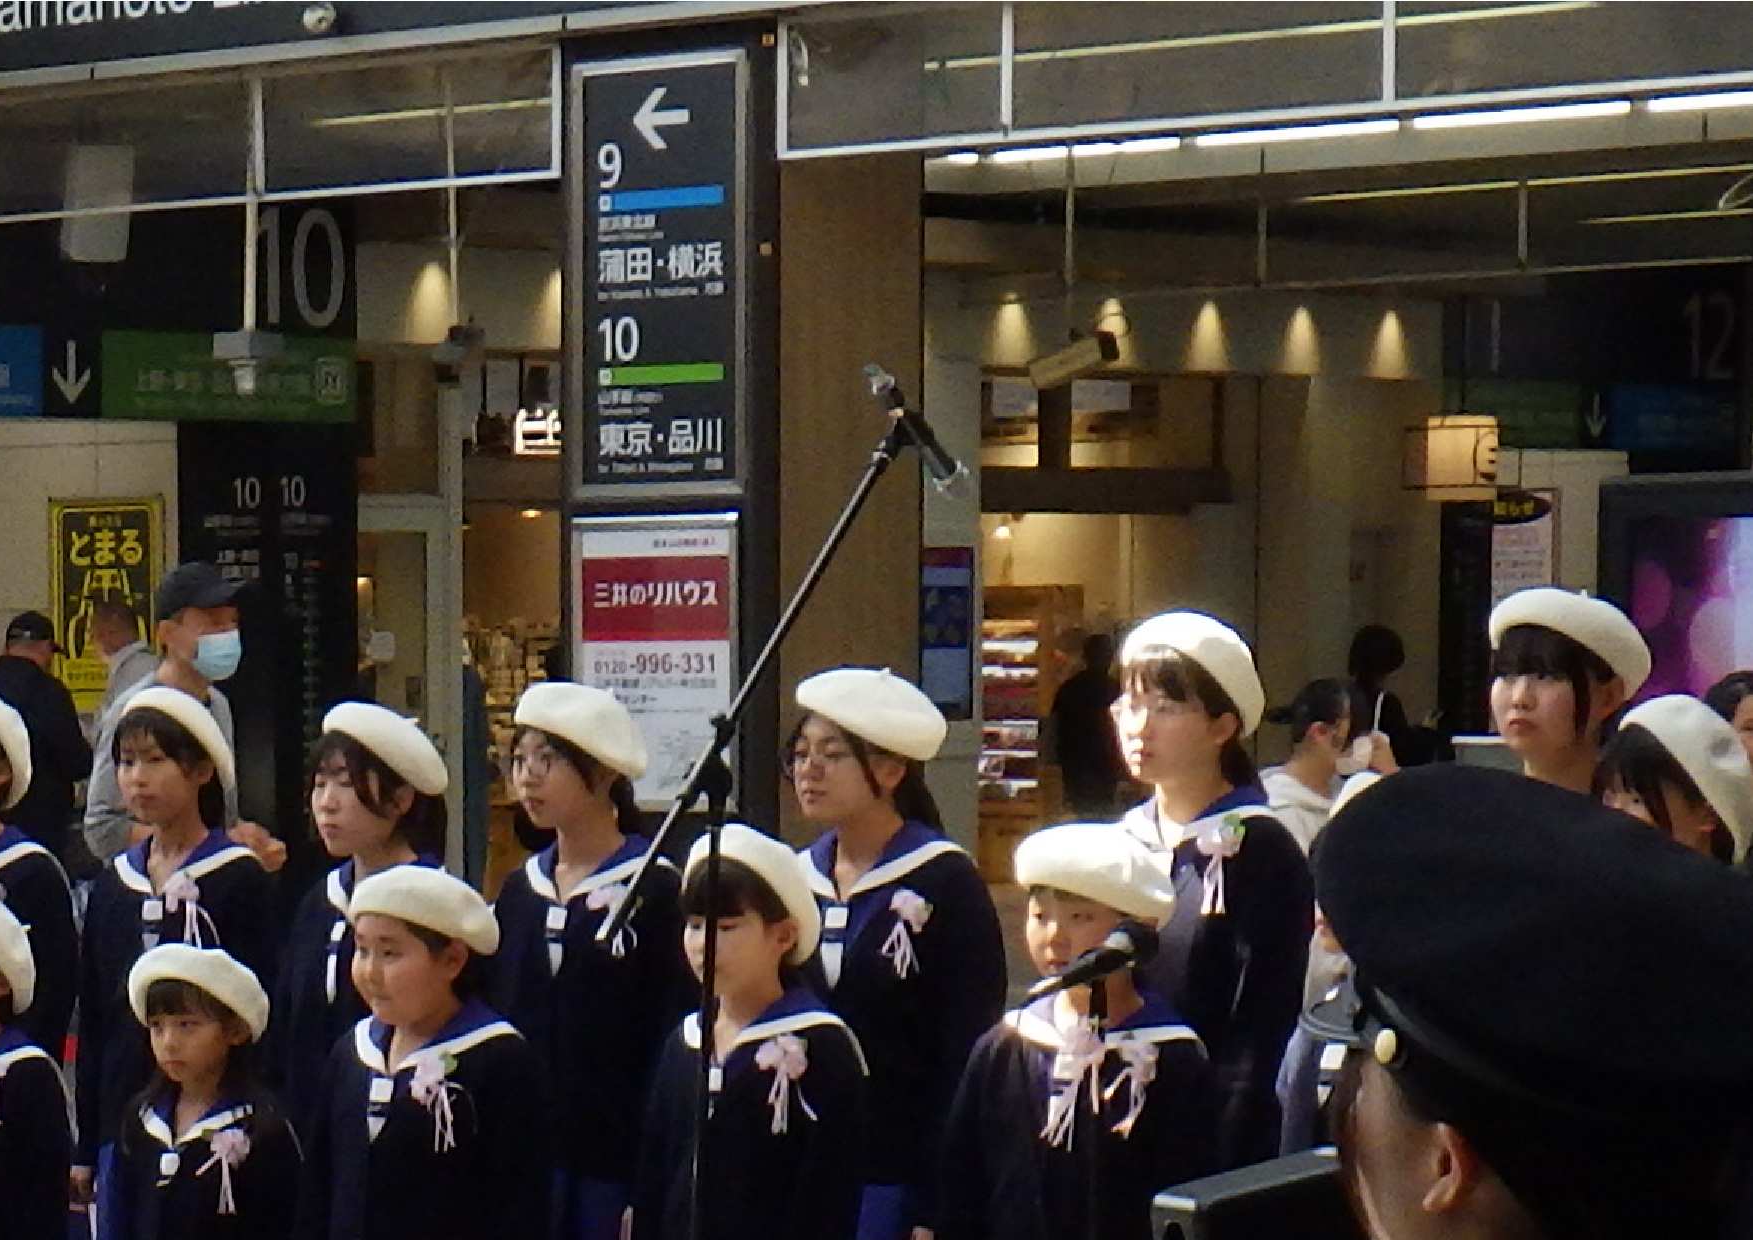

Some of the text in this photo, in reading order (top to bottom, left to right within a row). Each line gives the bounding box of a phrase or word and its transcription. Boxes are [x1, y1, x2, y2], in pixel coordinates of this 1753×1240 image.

[598, 142, 622, 188] 9
[599, 241, 723, 283] 蒲田・横浜
[597, 316, 640, 362] 10
[599, 417, 723, 457] 東京・品川
[232, 476, 261, 508] 10
[280, 475, 306, 507] 10
[70, 529, 143, 567] とまる
[593, 580, 719, 608] 三井のリハウス
